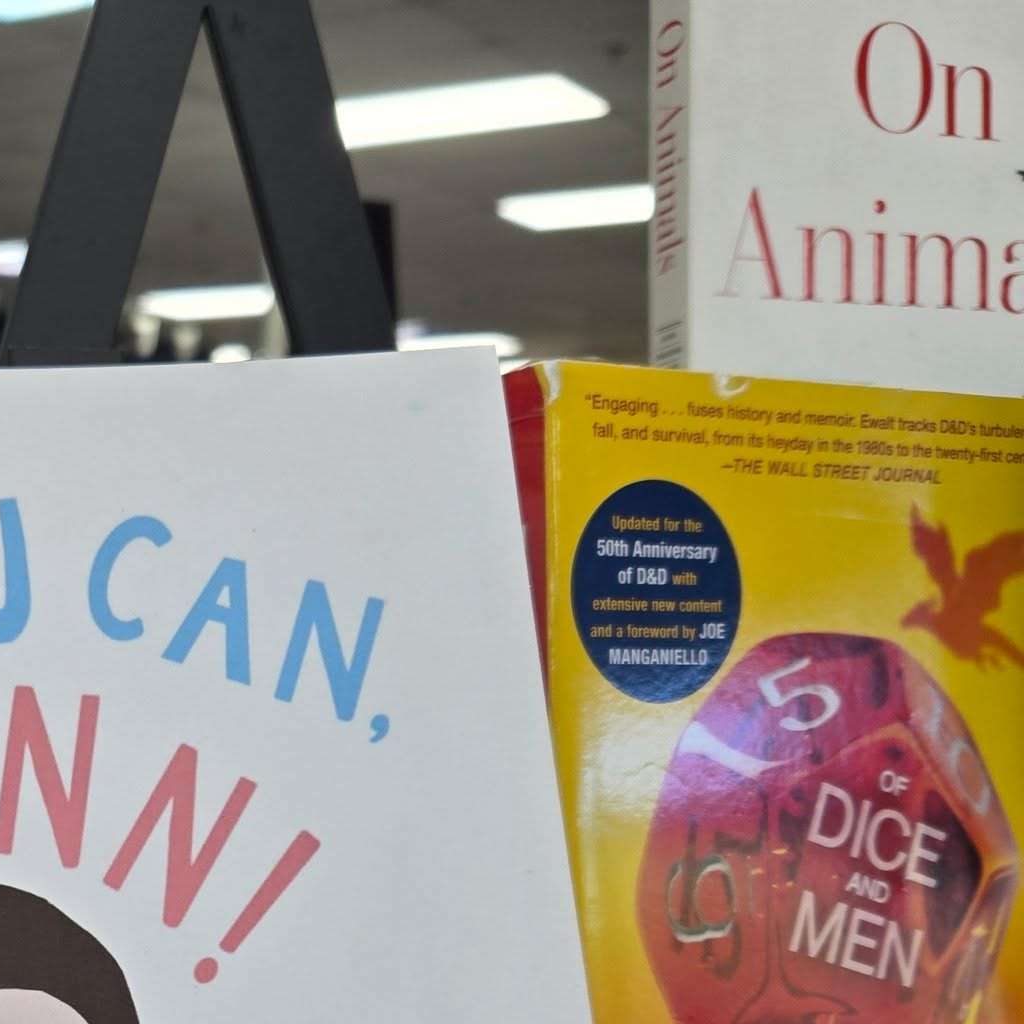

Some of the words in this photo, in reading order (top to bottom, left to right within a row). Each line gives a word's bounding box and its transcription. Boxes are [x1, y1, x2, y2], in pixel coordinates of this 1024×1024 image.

[853, 20, 1002, 142] On
[687, 402, 724, 418] fuses
[726, 404, 772, 425] history
[776, 410, 801, 424] and
[805, 412, 856, 428] memoir.
[860, 414, 896, 430] Ewalt
[898, 416, 936, 433] tracks
[592, 422, 617, 441] fall,
[621, 426, 648, 441] and
[652, 429, 709, 447] survival,
[713, 430, 744, 447] from
[748, 432, 764, 448] its
[767, 434, 814, 455] heyday
[817, 438, 829, 452] in
[832, 438, 853, 452] the
[856, 440, 893, 457] 1980s
[896, 443, 909, 457] to
[912, 444, 933, 459] the
[936, 447, 1003, 464] twenty-first
[767, 462, 808, 478] WALL
[813, 463, 871, 480] STREET
[874, 466, 942, 485] JOURNAL
[612, 515, 660, 533] Updated
[663, 517, 680, 532] for
[684, 519, 703, 533] the
[596, 539, 628, 557] 50th
[632, 540, 718, 563] Anniversary
[618, 567, 633, 585] of
[636, 567, 667, 585] D&D
[672, 571, 697, 586] with
[592, 597, 648, 611] extensive
[651, 600, 676, 612] new
[679, 599, 722, 613] content
[87, 515, 390, 744] CAN,
[590, 624, 613, 638] and
[616, 627, 624, 638] a
[627, 624, 679, 639] foreword
[682, 625, 696, 641] by
[699, 623, 727, 640] JOE
[608, 648, 708, 666] MANGANIELLO
[757, 657, 842, 731] 5
[878, 769, 911, 796] OF
[807, 782, 947, 888] DICE
[845, 873, 890, 904] AND
[788, 890, 923, 988] MEN
